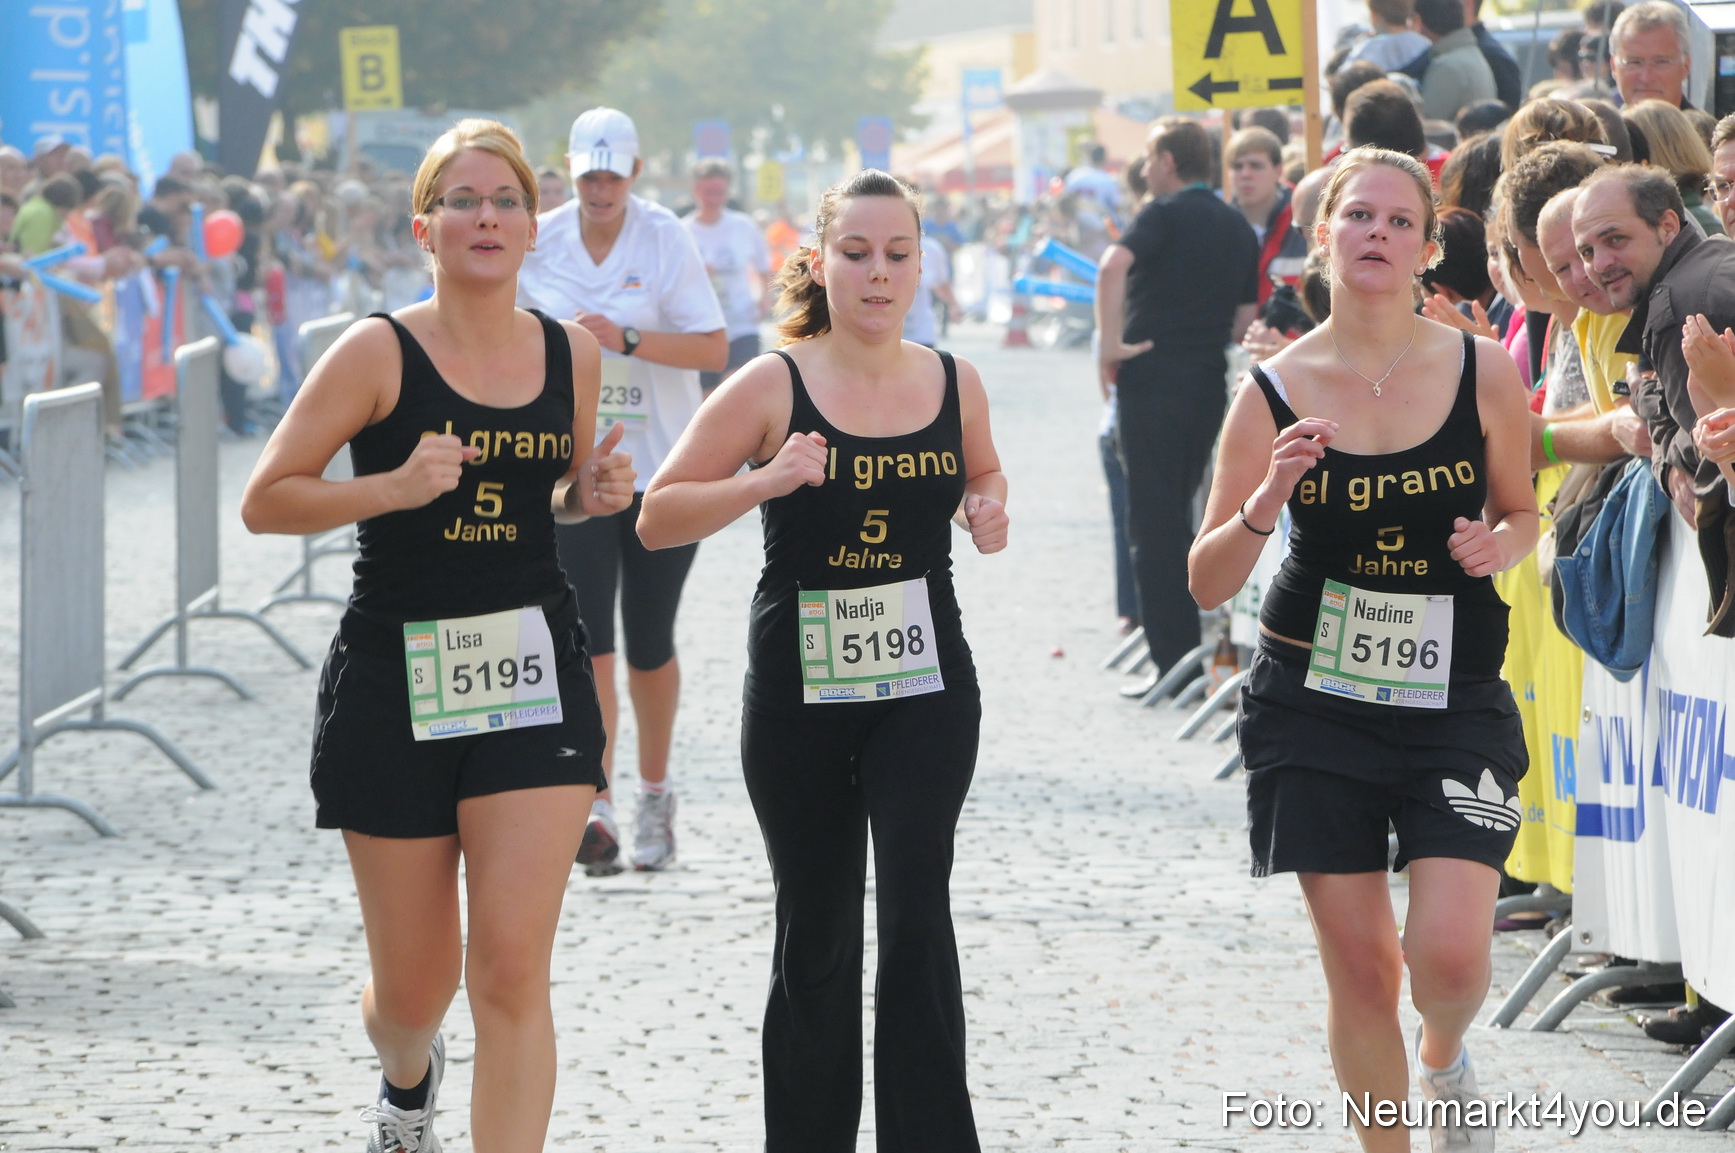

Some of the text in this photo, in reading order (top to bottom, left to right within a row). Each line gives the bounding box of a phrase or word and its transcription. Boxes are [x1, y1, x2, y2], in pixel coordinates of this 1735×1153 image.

[1203, 0, 1287, 59] A
[359, 53, 386, 92] B
[601, 385, 642, 406] 239
[468, 429, 572, 466] grano
[853, 451, 957, 490] grano
[1300, 460, 1475, 511] el grano
[473, 481, 504, 518] 5
[860, 509, 889, 544] 5
[1376, 525, 1405, 551] 5
[828, 545, 903, 569] Jahre
[1348, 554, 1428, 576] Jahre
[835, 596, 884, 622] Nadja
[1353, 596, 1414, 624] Nadine
[445, 629, 483, 651] Lisa
[805, 633, 815, 650] S
[1320, 621, 1330, 638] S
[842, 624, 925, 664] 5198
[1351, 633, 1440, 670] 5196
[414, 667, 424, 684] S
[452, 654, 543, 695] 5195
[891, 674, 940, 690] PFLEIDERER
[1320, 677, 1357, 692] BOCK
[1392, 688, 1445, 701] PFLEIDERER
[503, 706, 558, 720] PFLEIDERER
